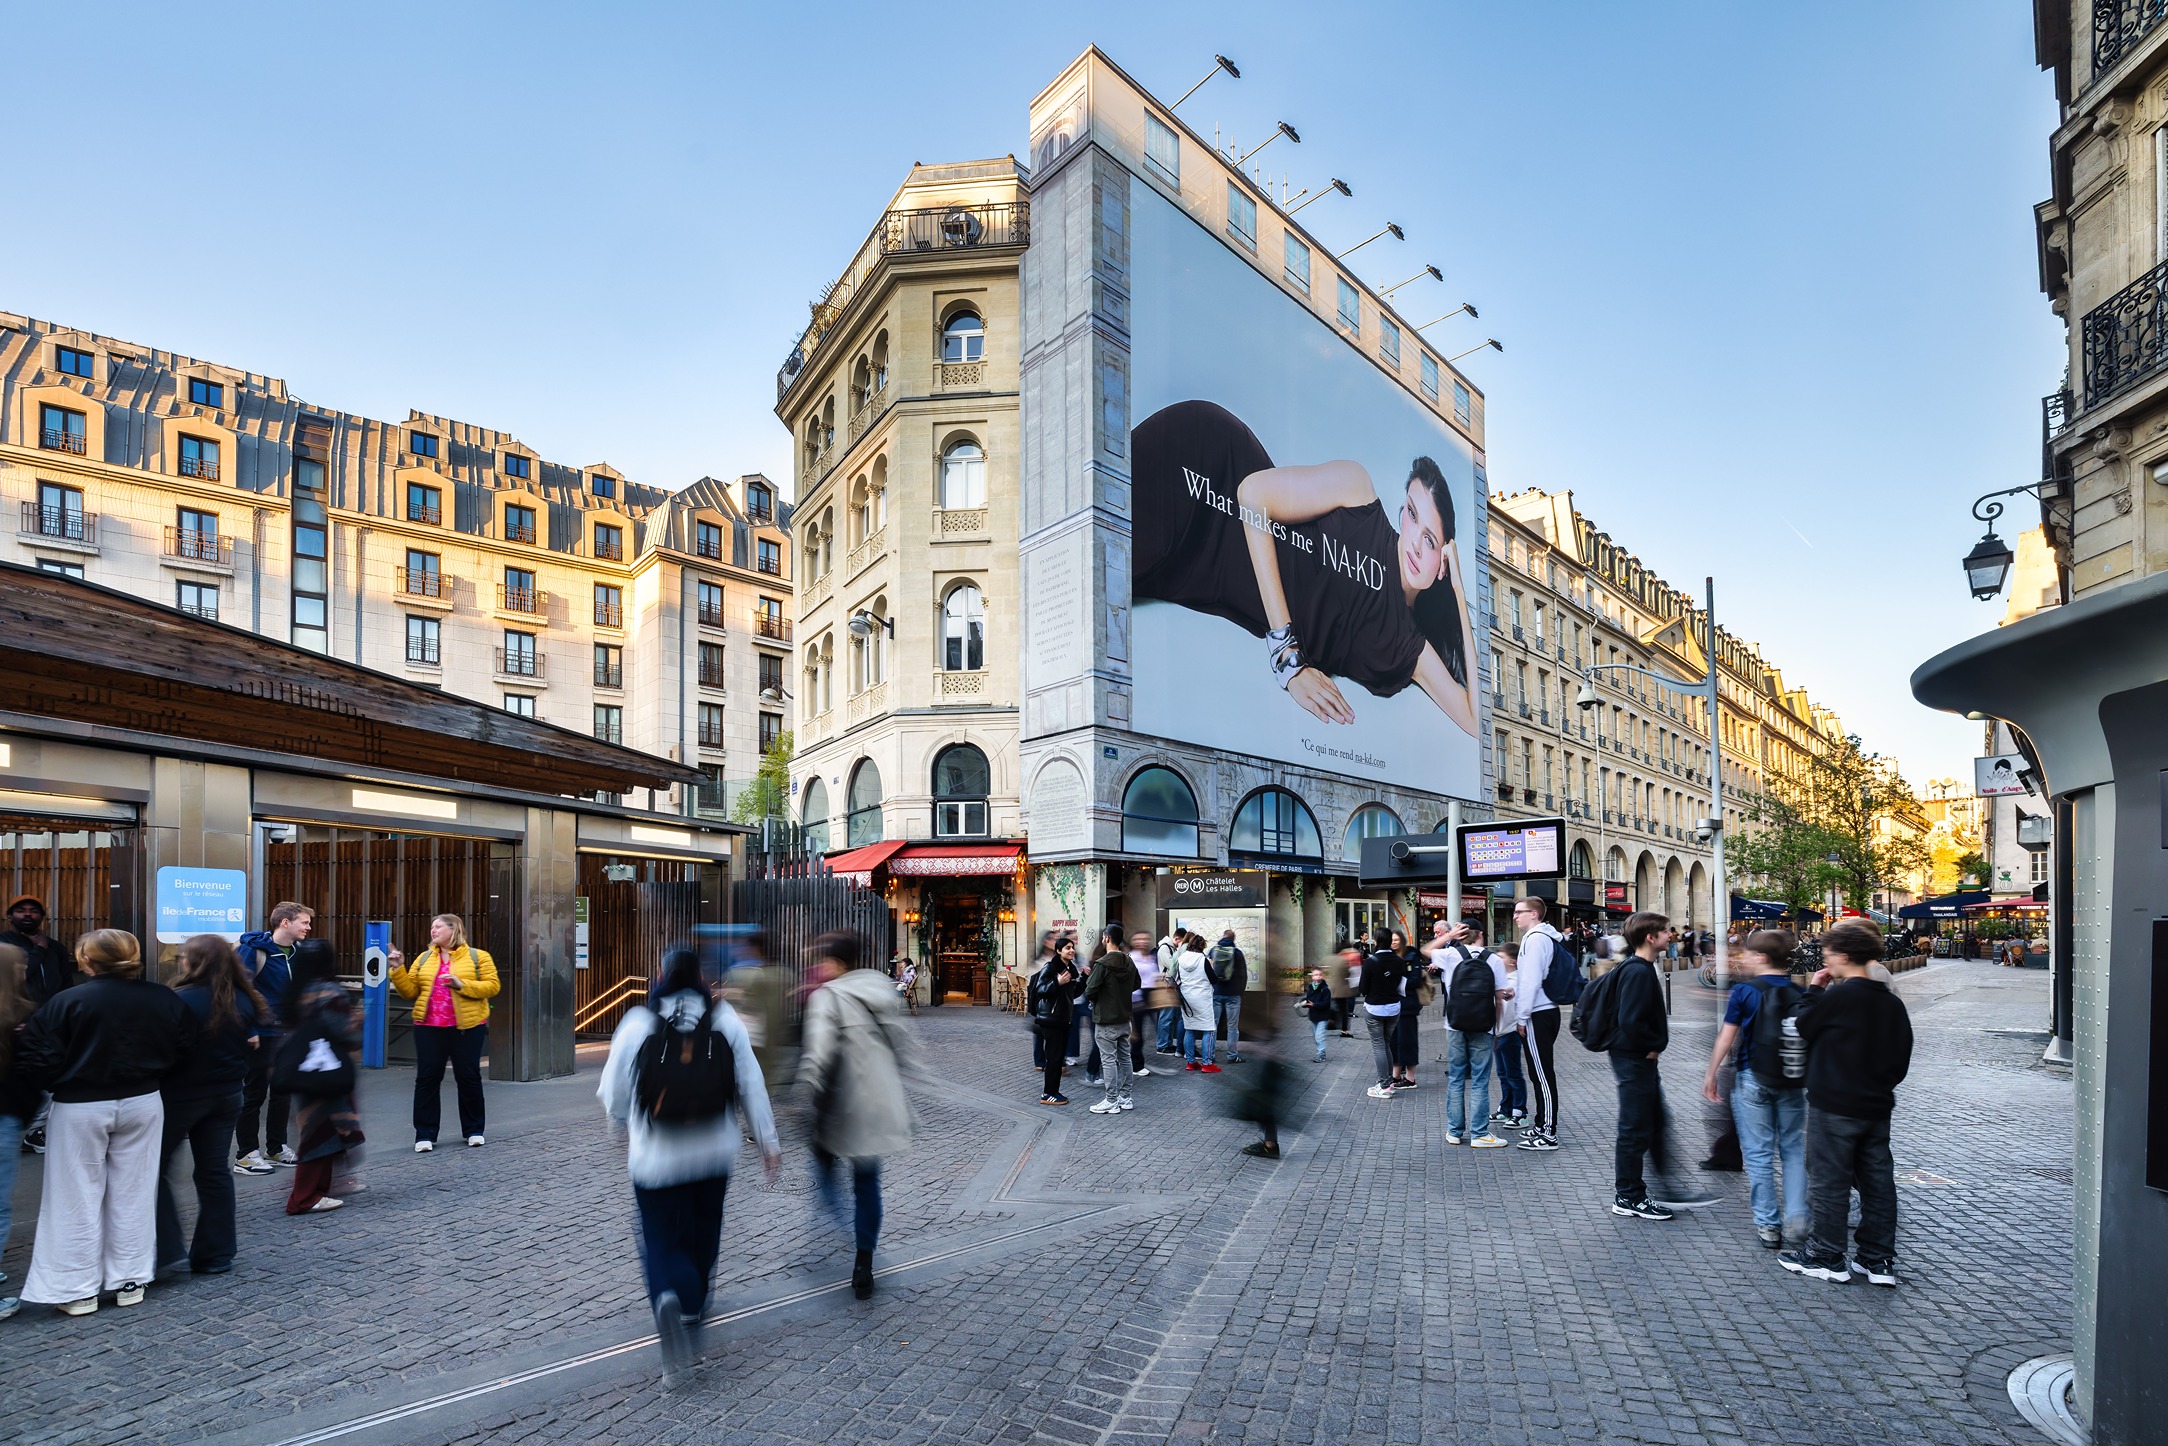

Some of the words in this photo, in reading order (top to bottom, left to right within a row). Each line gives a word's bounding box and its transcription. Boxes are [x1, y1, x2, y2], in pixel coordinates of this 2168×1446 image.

[1181, 466, 1233, 516] What
[1239, 507, 1287, 541] makes
[1291, 530, 1314, 554] me
[1316, 744, 1326, 756] qui
[1328, 748, 1338, 757] me
[1340, 750, 1354, 760] rend
[1354, 752, 1386, 768] na-kd.com
[174, 879, 232, 890] Bienvenue
[1778, 1016, 1808, 1078] adidas
